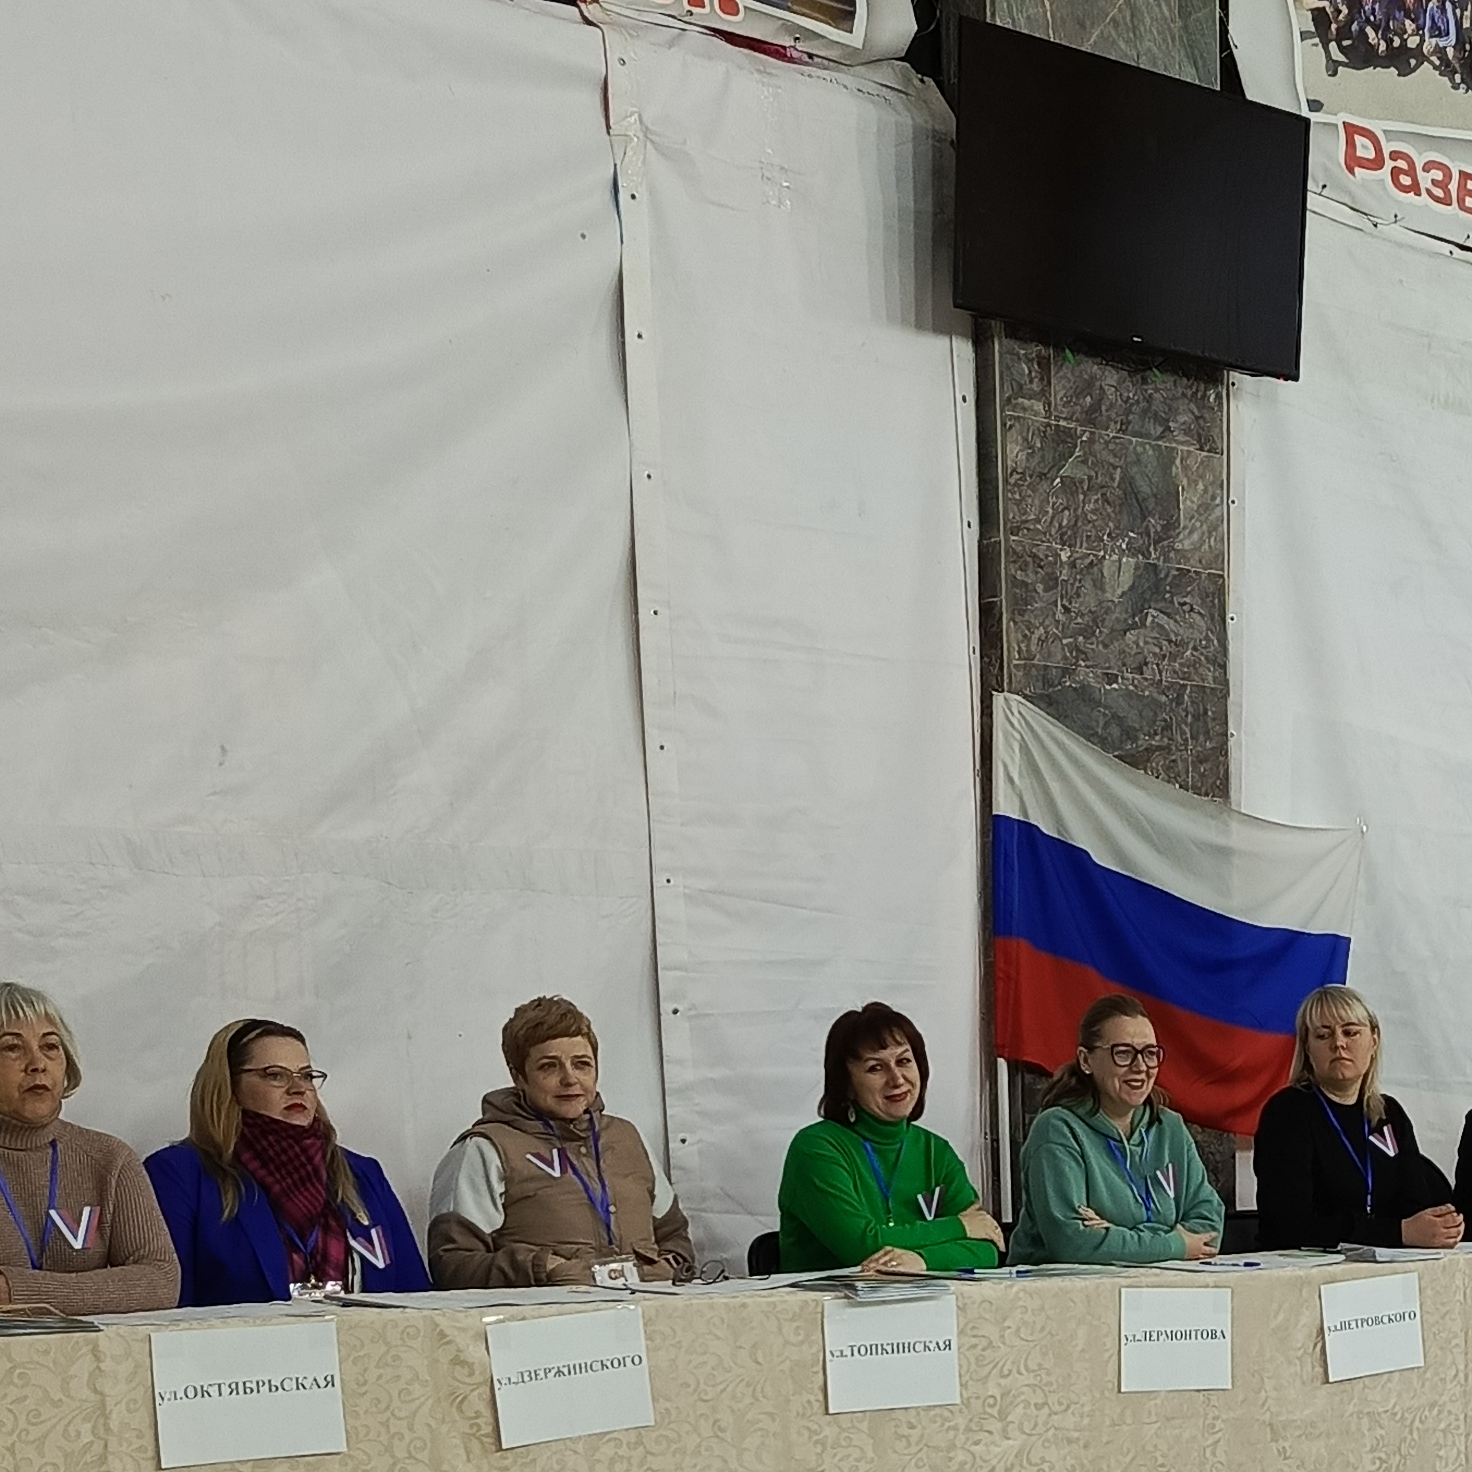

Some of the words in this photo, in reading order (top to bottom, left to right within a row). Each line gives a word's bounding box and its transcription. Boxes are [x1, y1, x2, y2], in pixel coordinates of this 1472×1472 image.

[829, 1338, 952, 1362] ул.ТОПКИНСКАЯ
[496, 1354, 643, 1390] ул.ДЗЕРЖИНСКОГО
[158, 1374, 336, 1406] ул.ОКТЯБРЬСКАЯ
